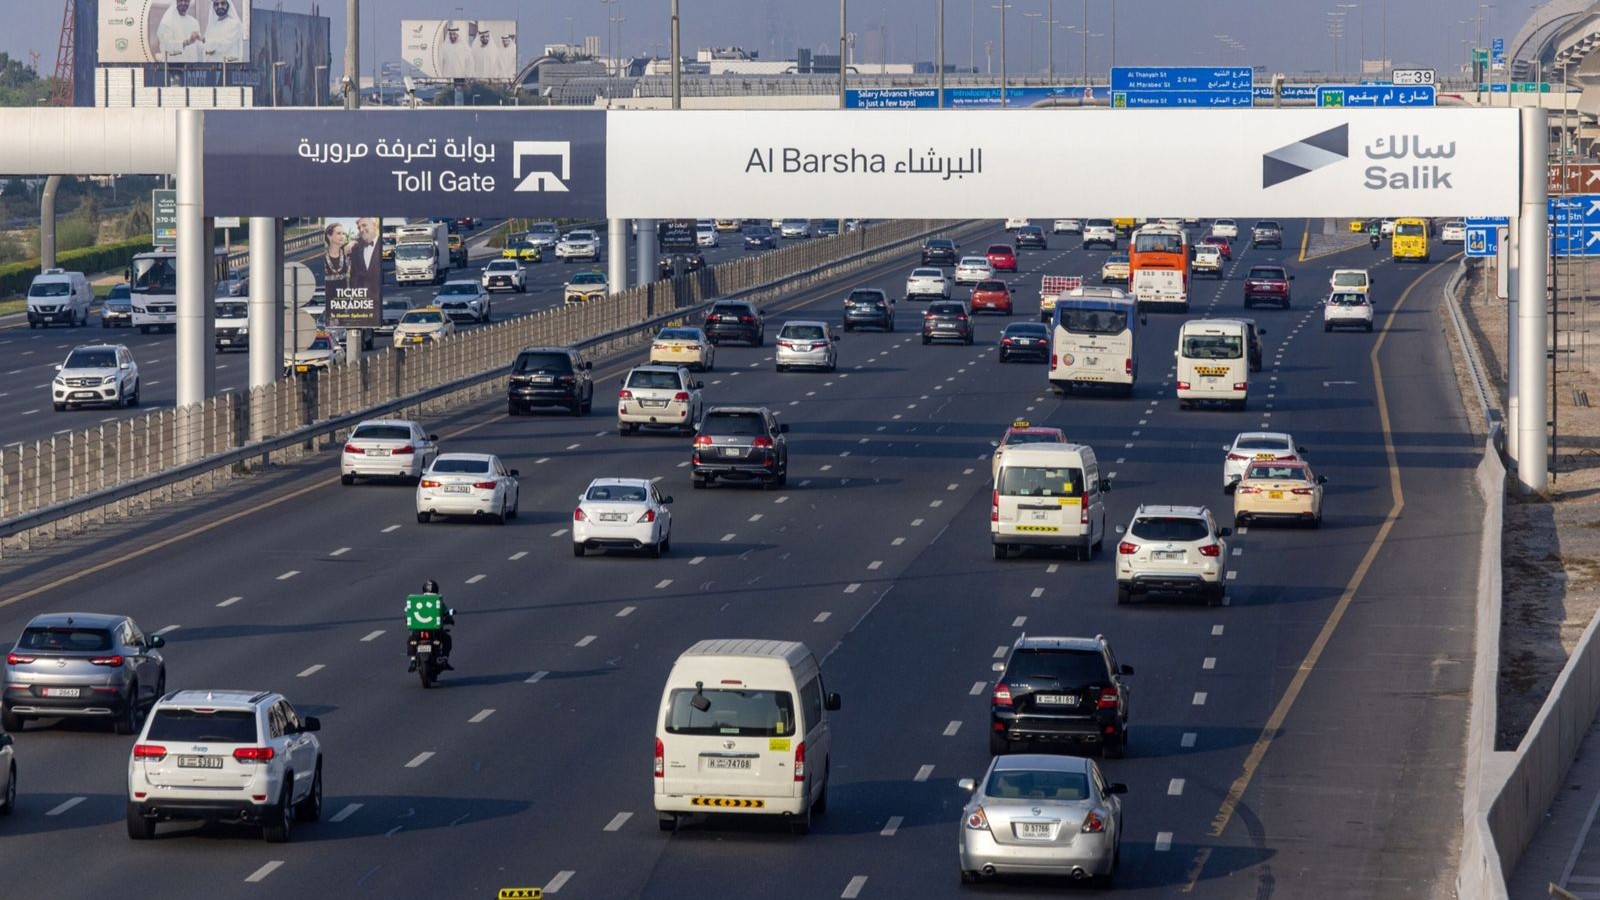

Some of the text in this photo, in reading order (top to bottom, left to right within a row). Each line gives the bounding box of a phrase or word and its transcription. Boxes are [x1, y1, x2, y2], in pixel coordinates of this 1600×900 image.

[1414, 72, 1431, 83] 39
[858, 90, 879, 99] Salary
[953, 90, 990, 98] Introducing
[1399, 90, 1429, 104] شارع
[866, 100, 878, 109] just
[886, 99, 898, 107] few
[899, 99, 916, 109] taps!
[298, 136, 496, 164] بوابة تعرفة مرورية
[1364, 134, 1456, 160] سالك
[745, 147, 886, 173] Al Barsha
[894, 147, 982, 181] البرشاء
[391, 170, 496, 192] Toll Gate
[1363, 165, 1454, 190] Salik
[336, 288, 368, 298] TICKET
[330, 300, 374, 310] PARADISE
[505, 890, 536, 898] TAXI
